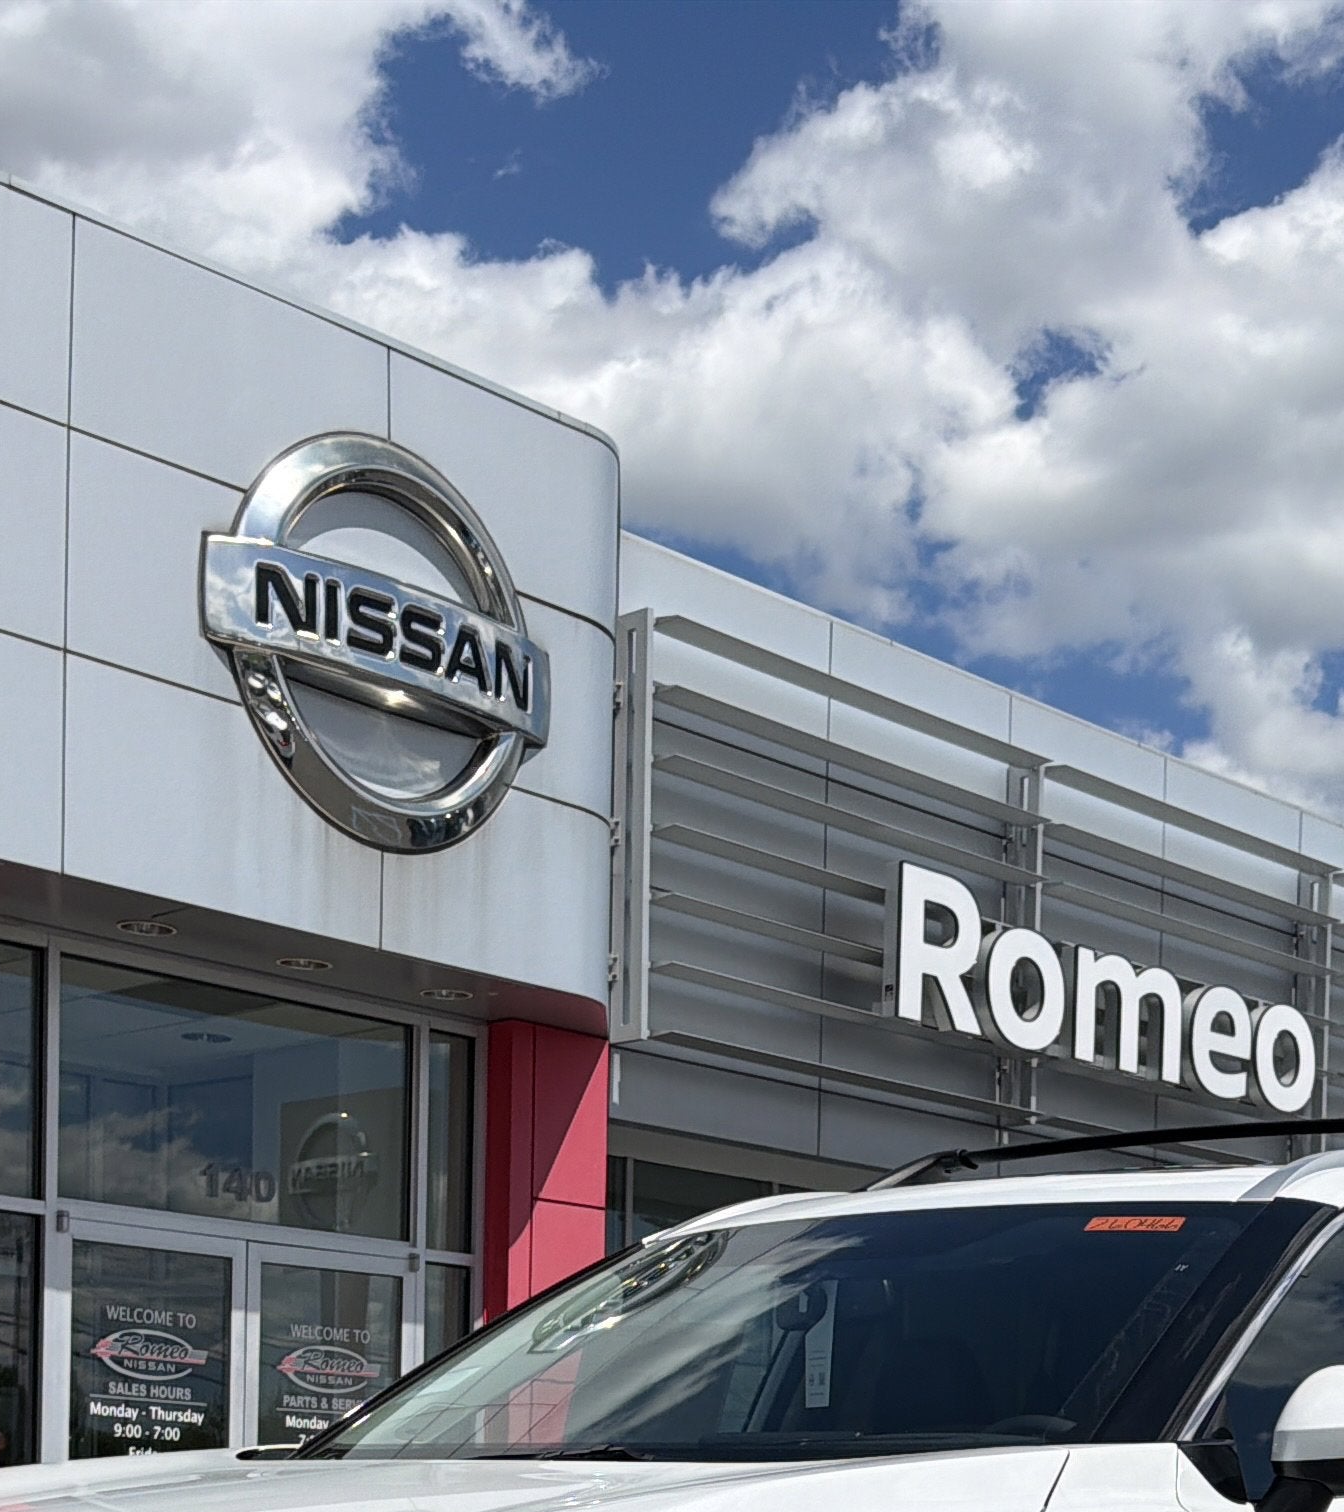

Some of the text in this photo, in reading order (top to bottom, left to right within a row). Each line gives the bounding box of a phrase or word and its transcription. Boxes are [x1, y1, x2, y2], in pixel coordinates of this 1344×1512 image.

[255, 561, 534, 714] NISSAN
[896, 860, 1316, 1113] Romeo
[199, 1162, 277, 1203] 140
[106, 1304, 197, 1329] WELCOME TO
[290, 1323, 371, 1344] WELCOME TO
[113, 1332, 189, 1360] Romeo
[123, 1358, 176, 1373] NISSAN
[298, 1349, 365, 1373] Romeo
[108, 1381, 192, 1400] SALES HOURS
[306, 1373, 353, 1386] NISSAN
[89, 1401, 139, 1422] Monday
[148, 1405, 205, 1426] Thursday
[283, 1394, 318, 1409] PARTS
[320, 1396, 329, 1409] &
[113, 1422, 142, 1439] 9:00
[153, 1425, 181, 1441] 7:00
